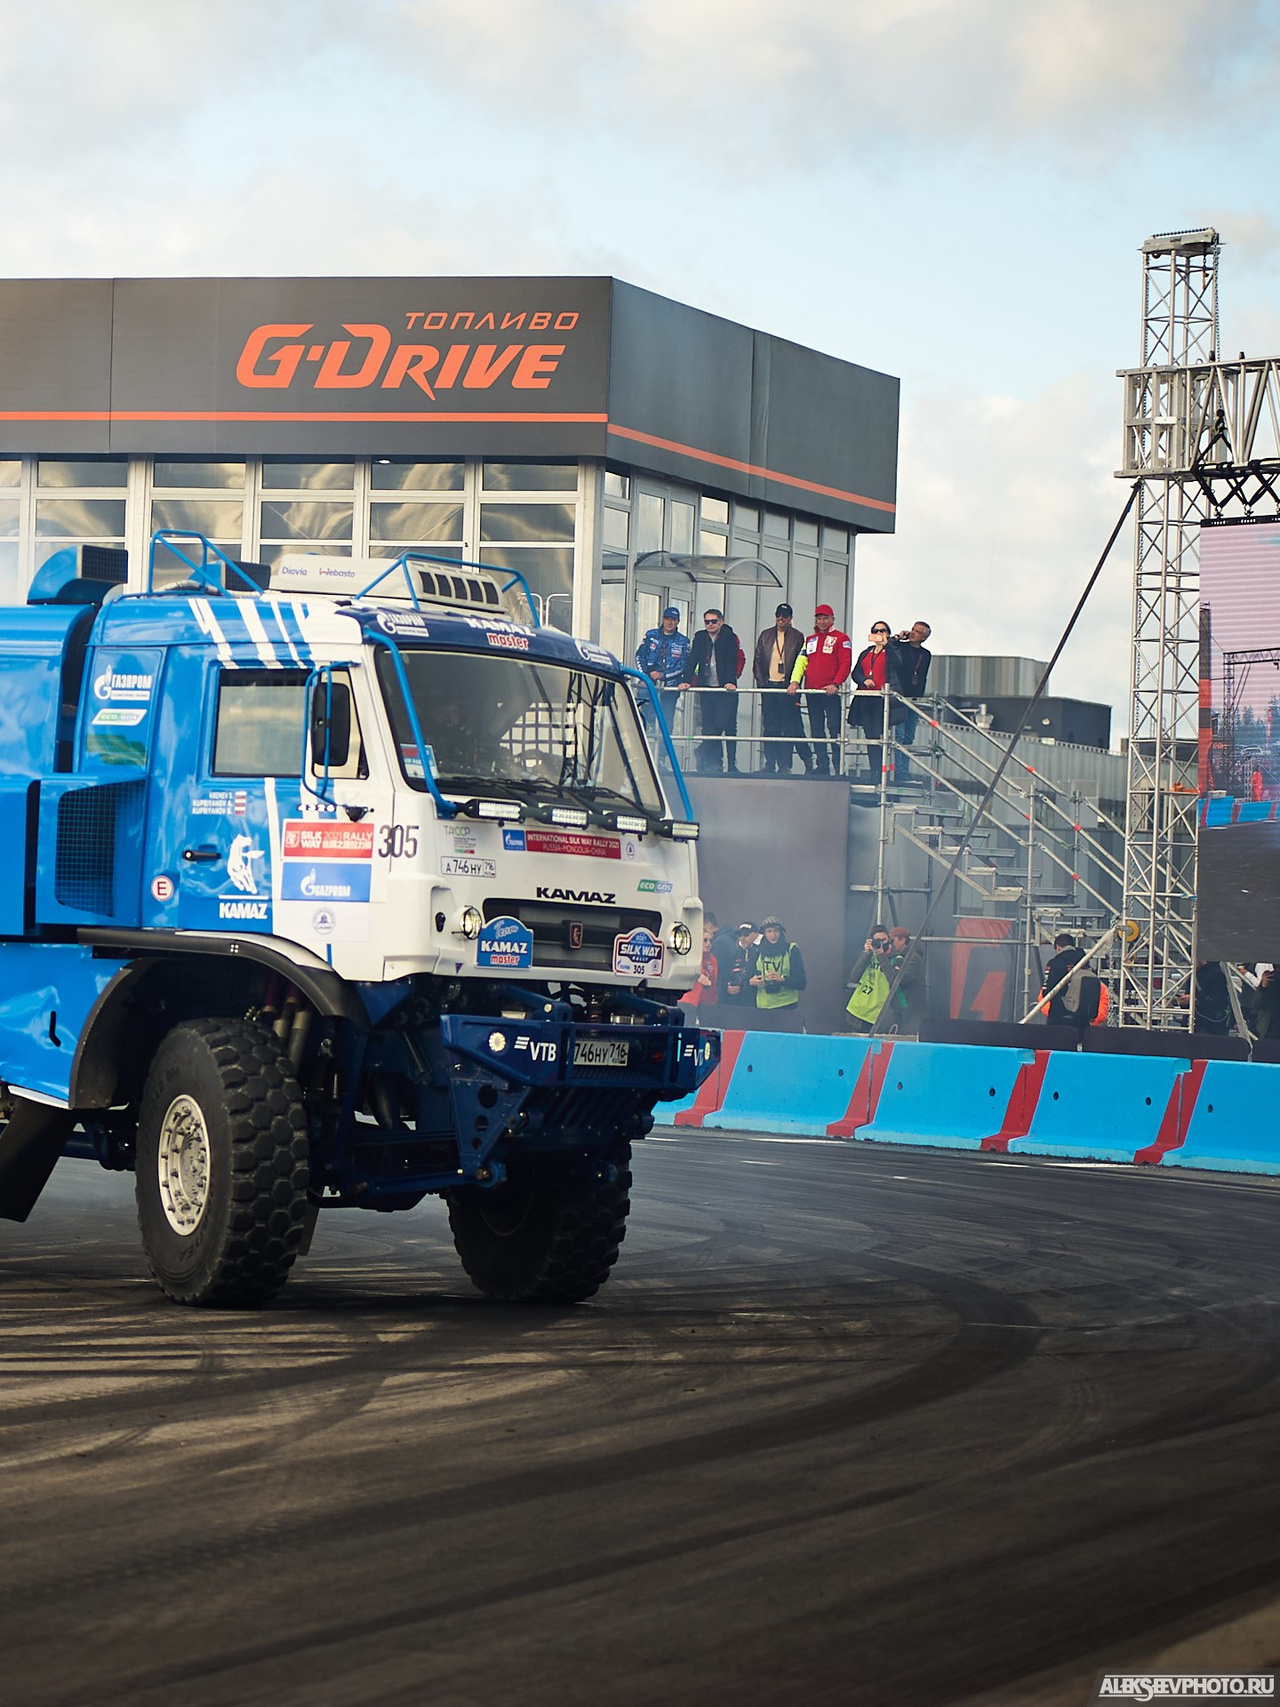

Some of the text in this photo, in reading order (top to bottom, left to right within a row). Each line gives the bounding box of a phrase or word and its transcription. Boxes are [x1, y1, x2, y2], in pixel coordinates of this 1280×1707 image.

[405, 311, 580, 330] ТОПЛИВО
[282, 566, 308, 576] Diavia
[463, 617, 536, 637] KAMAZ
[487, 633, 528, 650] master
[111, 674, 152, 689] ГАЗПРОМ
[300, 831, 323, 840] SILK
[343, 831, 373, 841] RALLY
[378, 824, 420, 858] 305
[527, 833, 568, 844] INTERNATIONAL
[569, 836, 581, 845] SILK
[581, 837, 593, 846] WAY
[593, 838, 608, 847] RALLY
[300, 840, 322, 849] WAY
[157, 881, 167, 896] E
[536, 886, 616, 904] KAMAZ
[219, 902, 268, 920] KAMAZ
[493, 920, 519, 940] Team
[481, 940, 528, 954] KAMAZ
[620, 943, 661, 957] SILK WAY
[490, 954, 519, 966] master
[763, 961, 782, 973] TV
[633, 964, 645, 975] 305
[862, 984, 874, 996] 27
[530, 1041, 557, 1061] VTB
